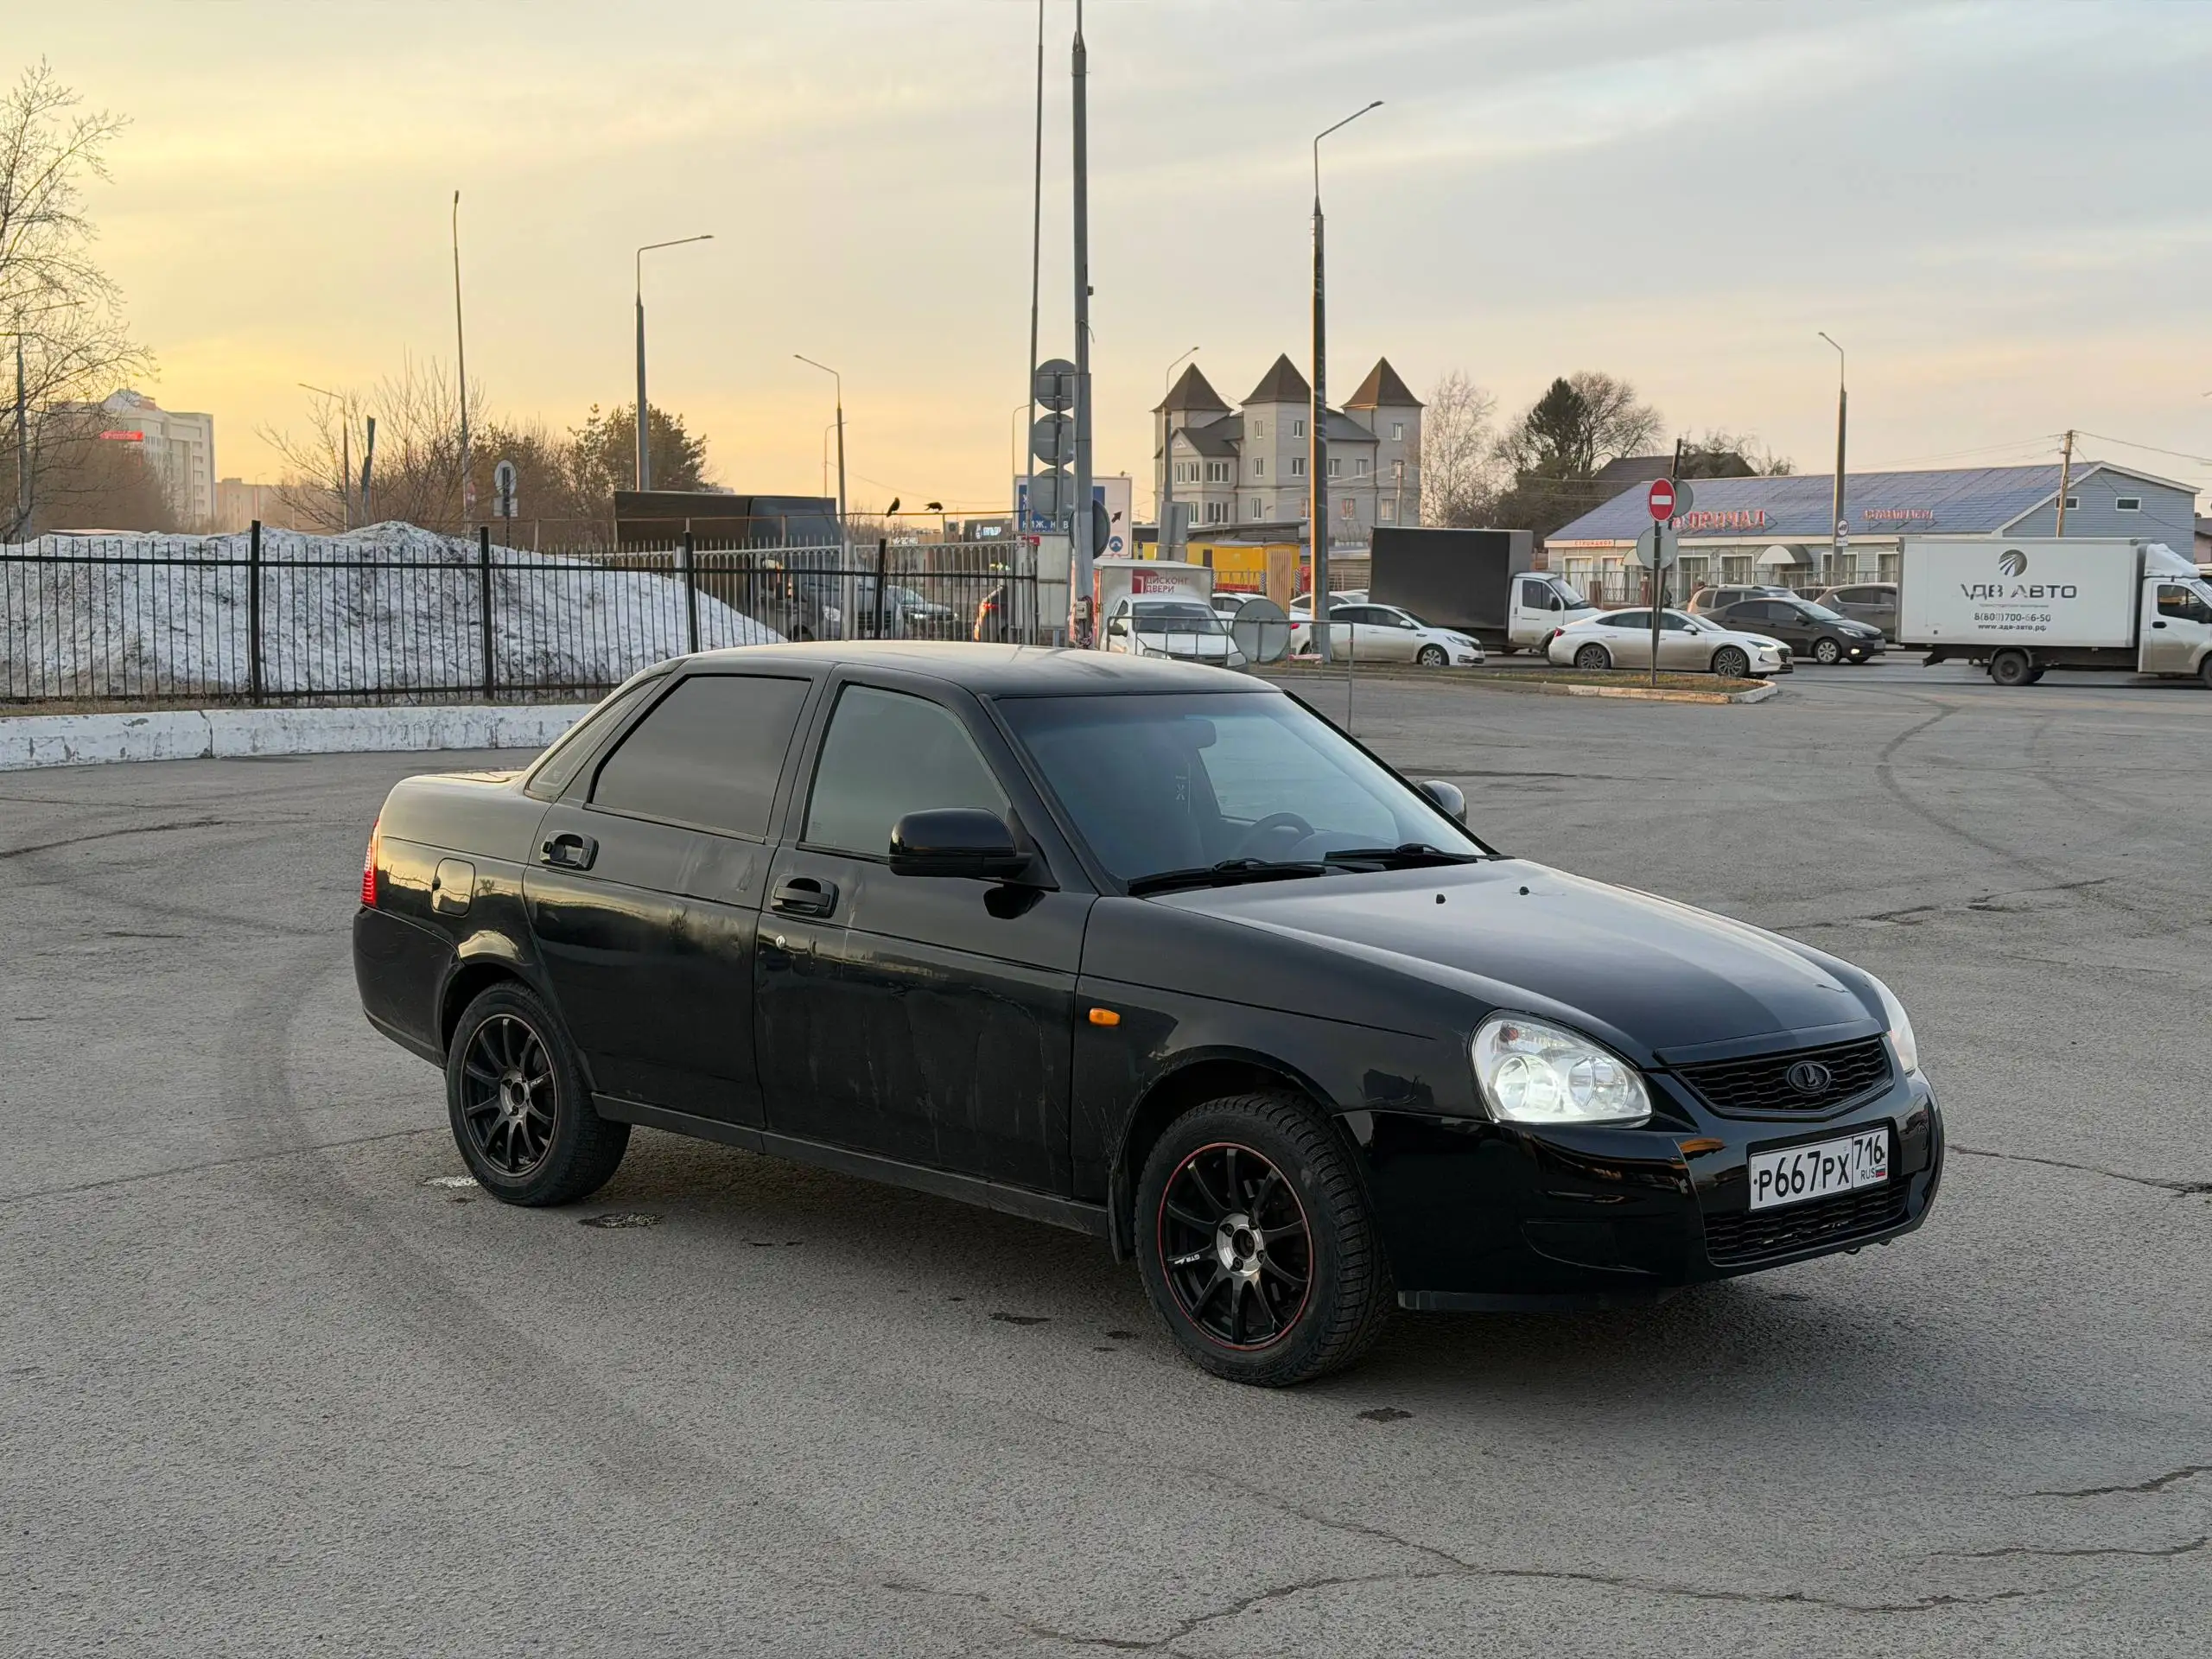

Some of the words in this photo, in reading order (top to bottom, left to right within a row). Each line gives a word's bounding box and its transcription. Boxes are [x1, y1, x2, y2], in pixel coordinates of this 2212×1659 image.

[1146, 585, 1174, 594] ДВЕРИ
[2010, 584, 2077, 598] АВТО
[1974, 612, 2051, 622] 8(800)700-66-50
[1758, 1150, 1850, 1202] Р667РХ
[1853, 1135, 1883, 1170] 716
[1860, 1167, 1875, 1181] RUS
